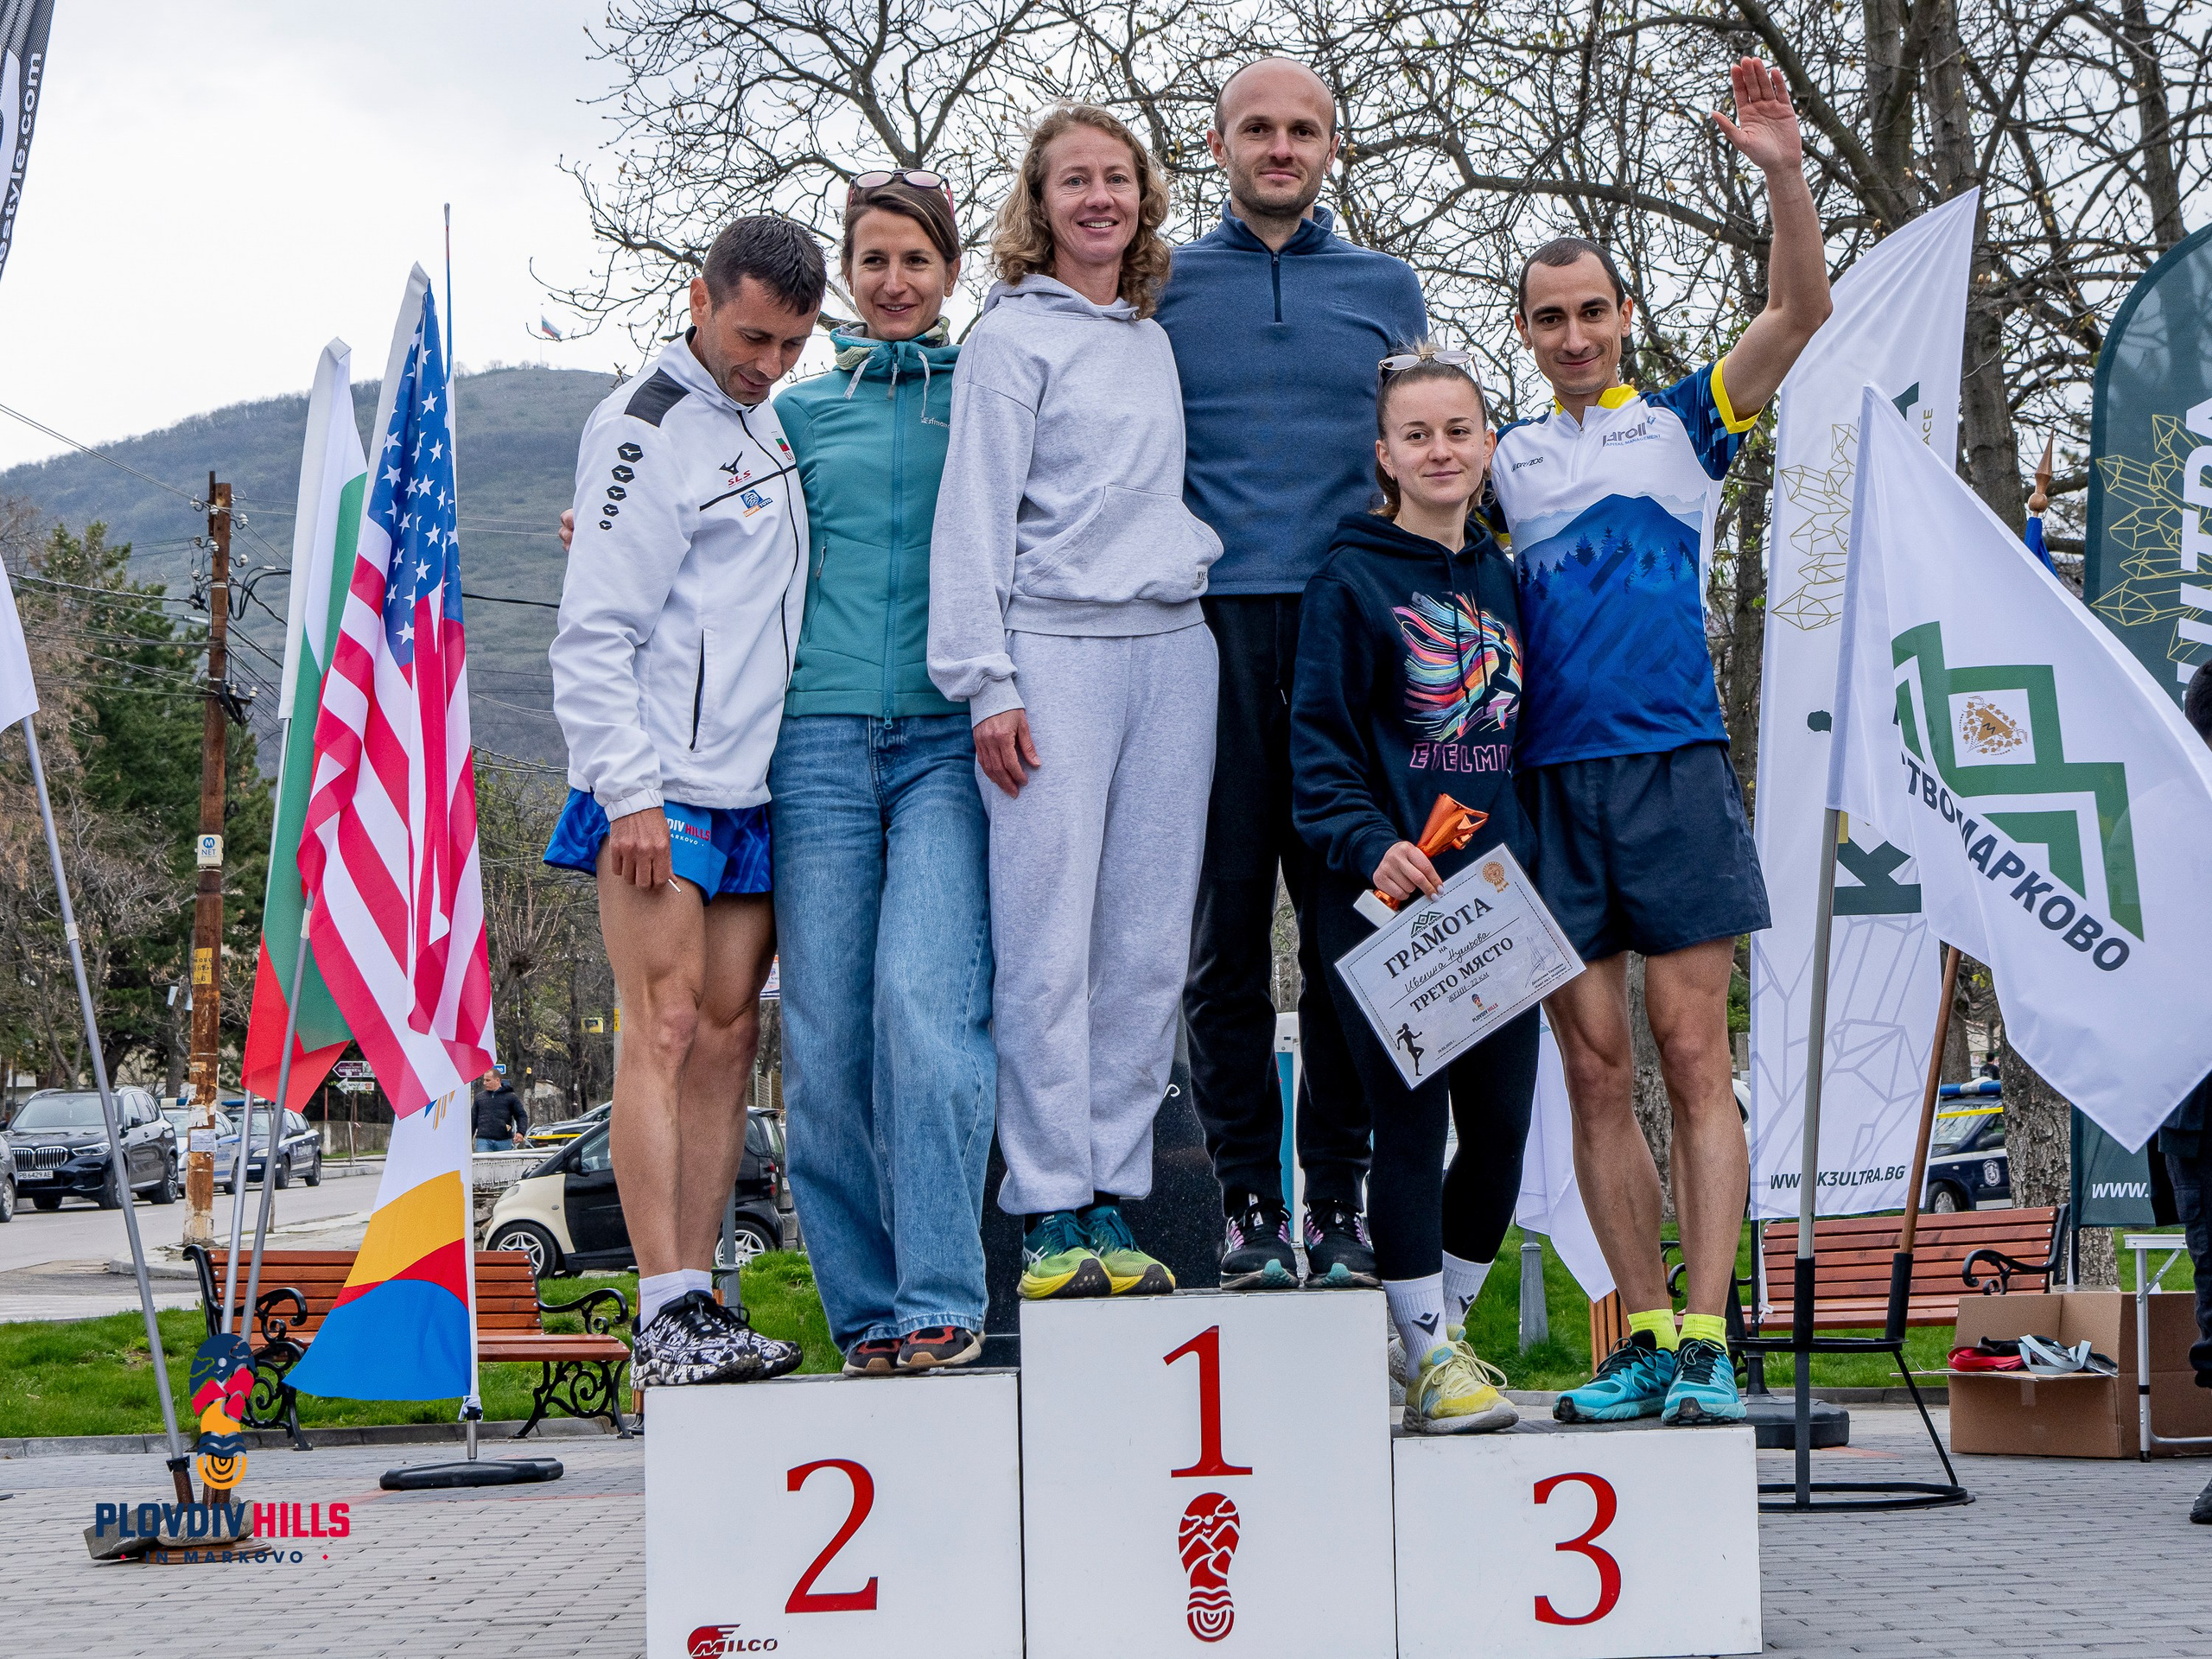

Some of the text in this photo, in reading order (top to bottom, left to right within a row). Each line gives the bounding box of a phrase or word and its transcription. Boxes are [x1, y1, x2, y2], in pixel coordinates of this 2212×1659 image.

[0, 53, 41, 272] estyle.com
[1922, 408, 1934, 446] ACE
[728, 469, 751, 486] SLS
[1409, 742, 1511, 772] EELMI
[1901, 751, 1955, 823] ТВО
[665, 817, 710, 842] DIV HILLS
[671, 833, 698, 845] ARKOVO
[1383, 898, 1493, 979] ГРАМОТА
[1438, 945, 1447, 954] НА
[1410, 974, 1459, 1013] ТРЕТО
[1458, 938, 1514, 980] МЯСТО
[1770, 1166, 1906, 1190] WWK3ULTRA.BG
[2092, 1182, 2149, 1198] WWW.
[1163, 1325, 1253, 1478] 1
[785, 1459, 878, 1614] 2
[1533, 1472, 1621, 1626] 3
[691, 1638, 779, 1656] MILCO
